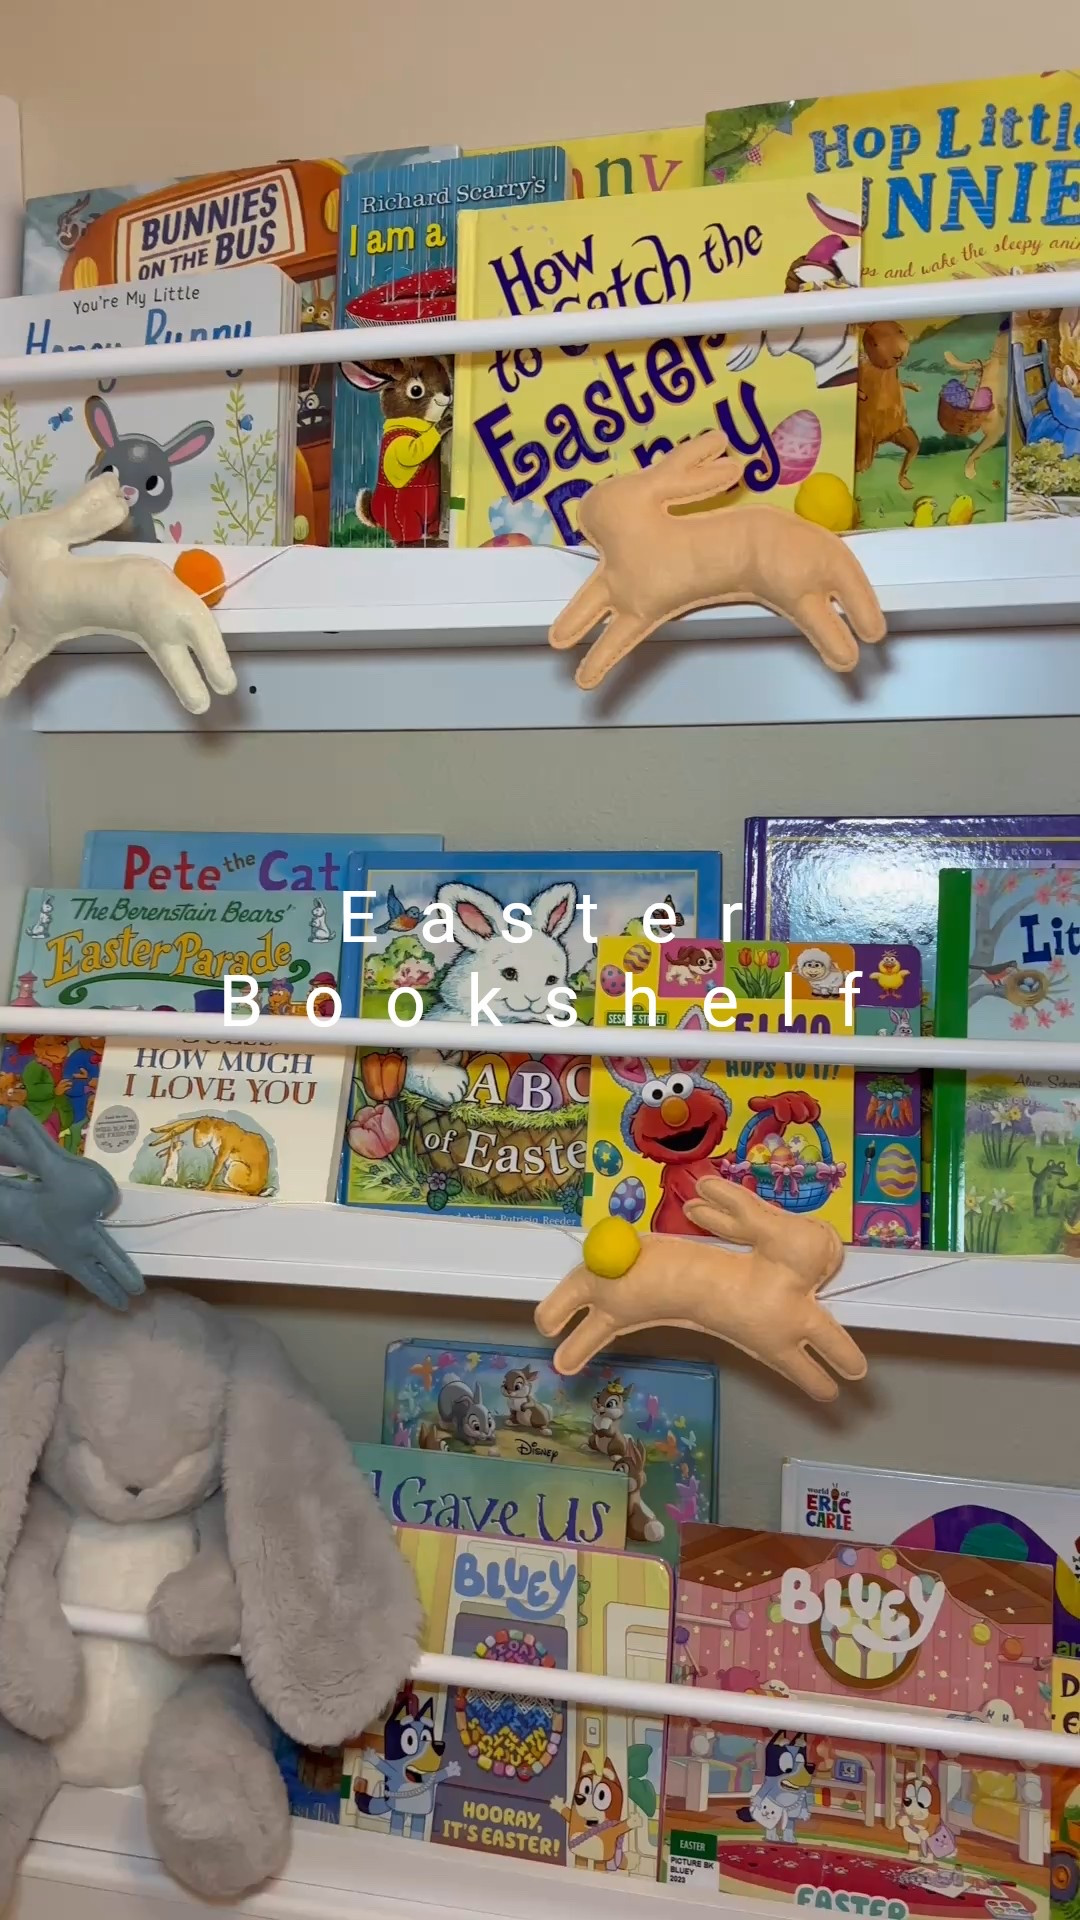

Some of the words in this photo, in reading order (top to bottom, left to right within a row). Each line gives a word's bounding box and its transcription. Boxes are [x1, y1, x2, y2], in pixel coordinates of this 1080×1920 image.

[809, 124, 921, 173] Hop
[936, 102, 1080, 159] Littl
[361, 187, 451, 214] Richard
[456, 175, 546, 203] Scarry's
[142, 183, 278, 251] BUNNIES
[138, 260, 165, 280] ON
[170, 248, 208, 274] THE
[215, 219, 277, 266] BUS
[349, 225, 358, 257] I
[366, 224, 415, 255] am
[425, 222, 447, 248] a
[698, 222, 764, 275] the
[884, 262, 915, 278] and
[922, 253, 957, 275] wake
[960, 243, 986, 261] the
[993, 235, 1042, 255] sleepy
[488, 234, 594, 316] How
[73, 295, 118, 315] You're
[126, 291, 147, 309] My
[154, 286, 200, 303] Little
[488, 348, 543, 393] to
[473, 333, 727, 503] Easter
[123, 844, 221, 891] Pete
[222, 852, 256, 873] the
[258, 849, 340, 891] Cat
[1011, 847, 1053, 857] BOOK
[71, 897, 108, 921] The
[111, 897, 216, 923] Berenstain
[220, 901, 292, 924] Bears'
[43, 924, 173, 988] Easter
[169, 928, 292, 979] Parade
[608, 1013, 637, 1025] SESAE
[638, 1014, 666, 1025] STET
[134, 1048, 210, 1071] HOW
[218, 1051, 315, 1075] MUCH
[726, 1059, 776, 1079] HOPS
[123, 1073, 137, 1097] I
[147, 1074, 236, 1102] LOVE
[246, 1078, 318, 1105] YOU
[424, 1129, 458, 1154] of
[542, 1215, 577, 1226] Reeder
[391, 1475, 526, 1538] Gave
[806, 1510, 852, 1531] CARLE
[454, 1552, 576, 1621] BLUEY
[780, 1567, 946, 1653] BLUEY
[462, 1801, 543, 1833] HOORAY,
[442, 1819, 479, 1843] IT'S
[481, 1827, 561, 1857] EASTER!
[680, 1839, 706, 1852] EASTER
[669, 1875, 686, 1884] 2023
[670, 1866, 695, 1875] BLUEY
[671, 1856, 702, 1868] PICTURE
[703, 1861, 715, 1870] BK
